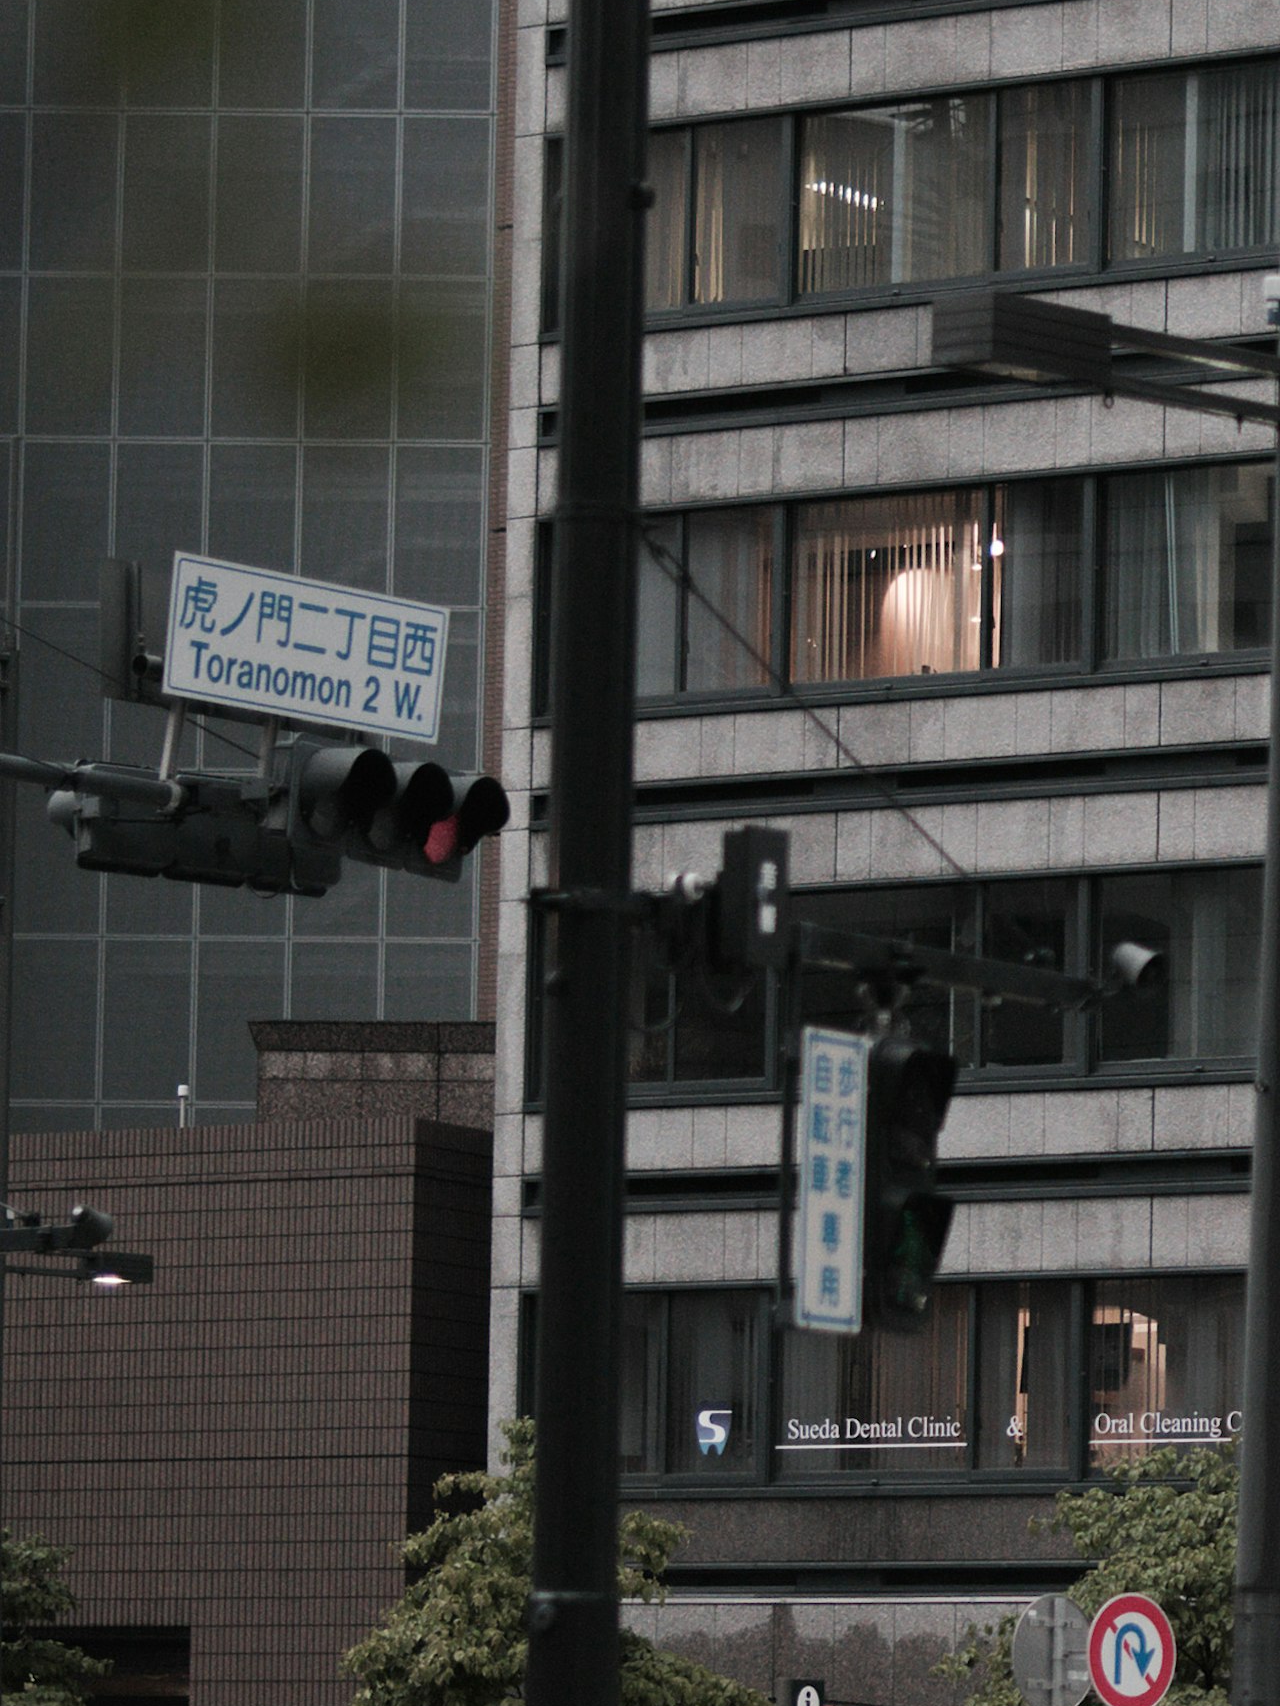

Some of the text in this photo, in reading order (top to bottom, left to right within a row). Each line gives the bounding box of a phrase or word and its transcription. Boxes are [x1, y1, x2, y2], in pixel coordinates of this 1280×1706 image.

[180, 576, 438, 676] 虎ノ門二丁目西
[190, 639, 422, 721] Toranomon 2 W.
[787, 1418, 840, 1440] Sueda
[845, 1417, 903, 1439] Dental
[907, 1415, 961, 1438] Clinic
[1006, 1415, 1024, 1437] &
[1094, 1412, 1134, 1434] Oral
[1140, 1411, 1222, 1437] Cleaning
